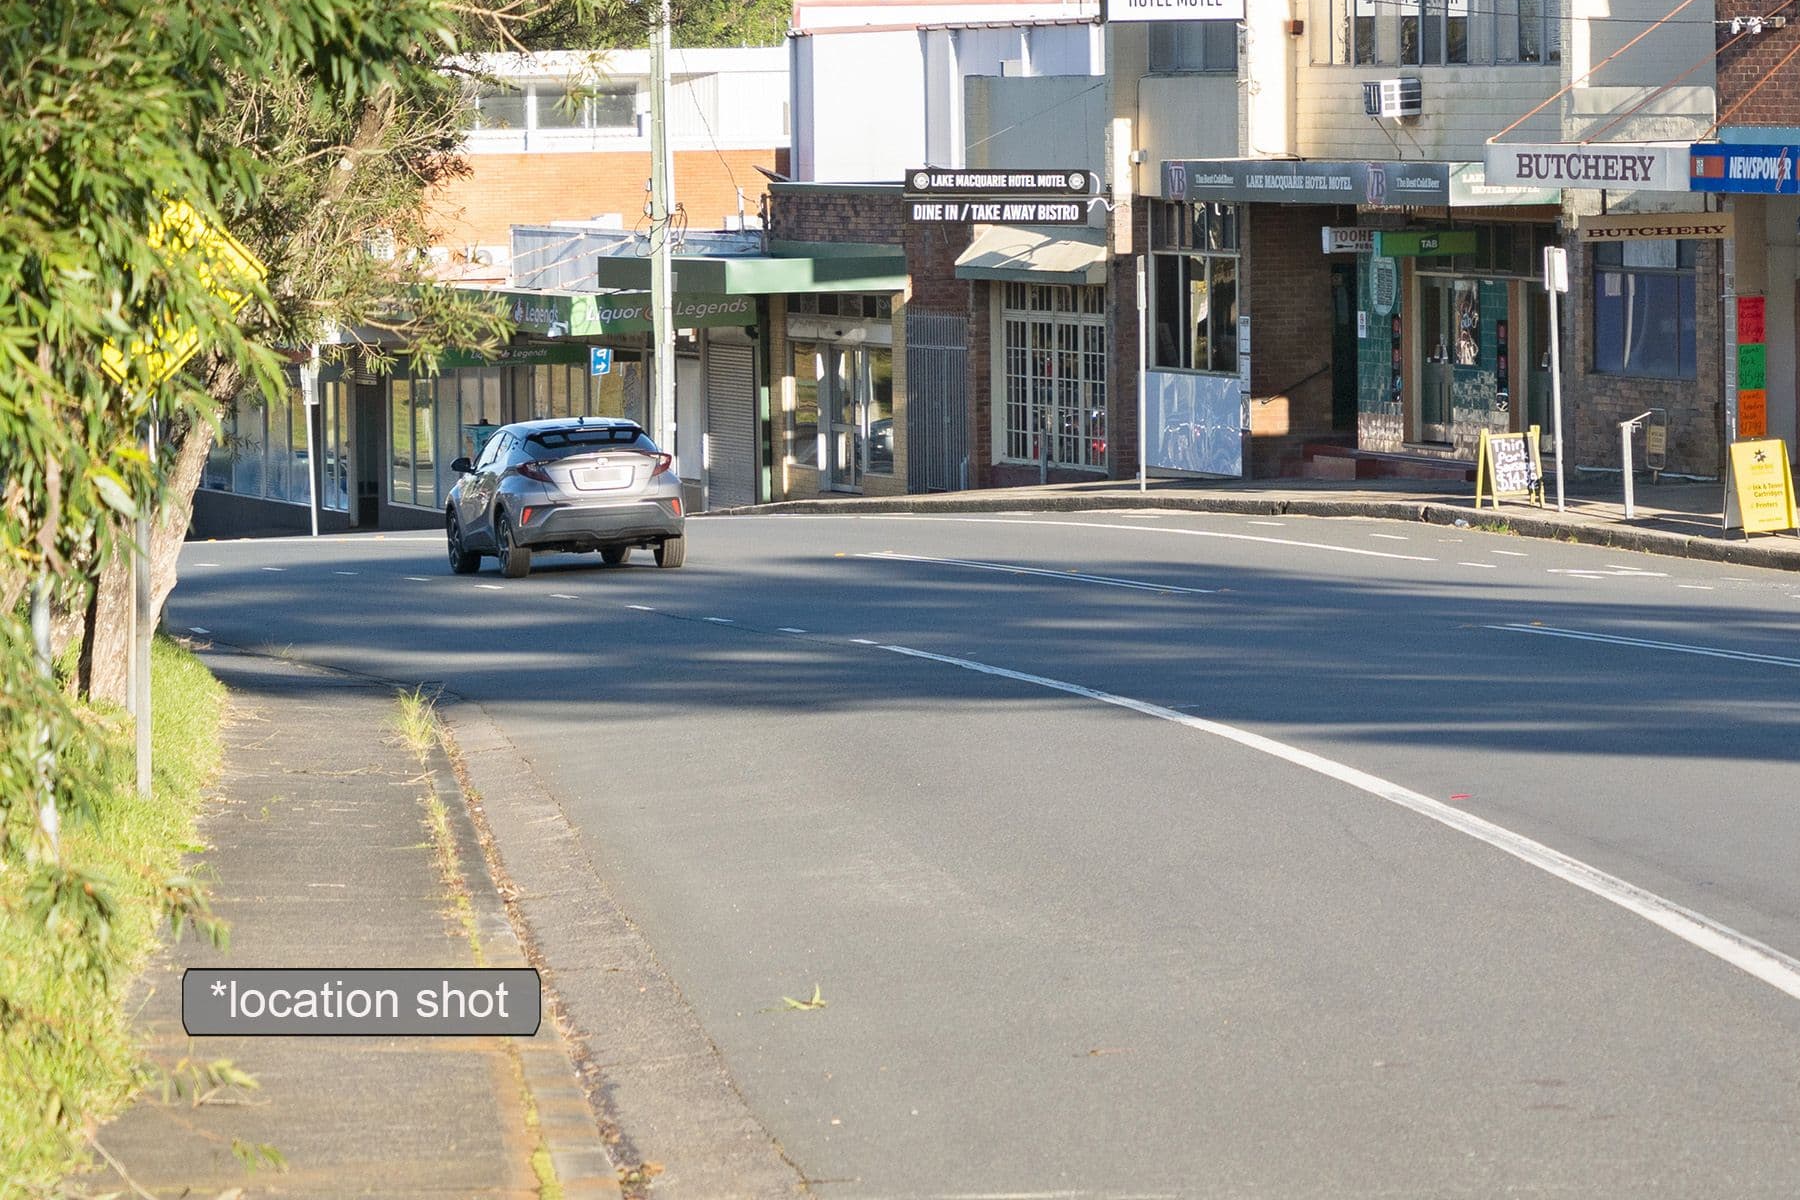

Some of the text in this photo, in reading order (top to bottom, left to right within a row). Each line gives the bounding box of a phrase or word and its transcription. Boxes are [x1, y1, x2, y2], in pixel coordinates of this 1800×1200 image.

[1516, 153, 1655, 182] BUTCHERY
[931, 174, 1067, 188] LAKE MACQUARIE HOTEL MOTEL
[1246, 175, 1352, 190] LAKE MACQUARIE HOTEL MOTEL
[913, 204, 942, 221] DINE
[944, 204, 958, 220] IN
[971, 204, 1000, 220] TAKE
[1002, 204, 1037, 220] AWAY
[1038, 203, 1079, 220] BISTRO
[1333, 230, 1374, 242] TOOHE
[1586, 225, 1726, 238] BUTCHERY
[1421, 239, 1438, 249] TAB
[525, 303, 559, 325] Legends
[586, 298, 748, 322] Liquor Legends
[513, 349, 547, 359] Legends
[1491, 439, 1525, 452] Thin
[1498, 449, 1528, 464] Pork
